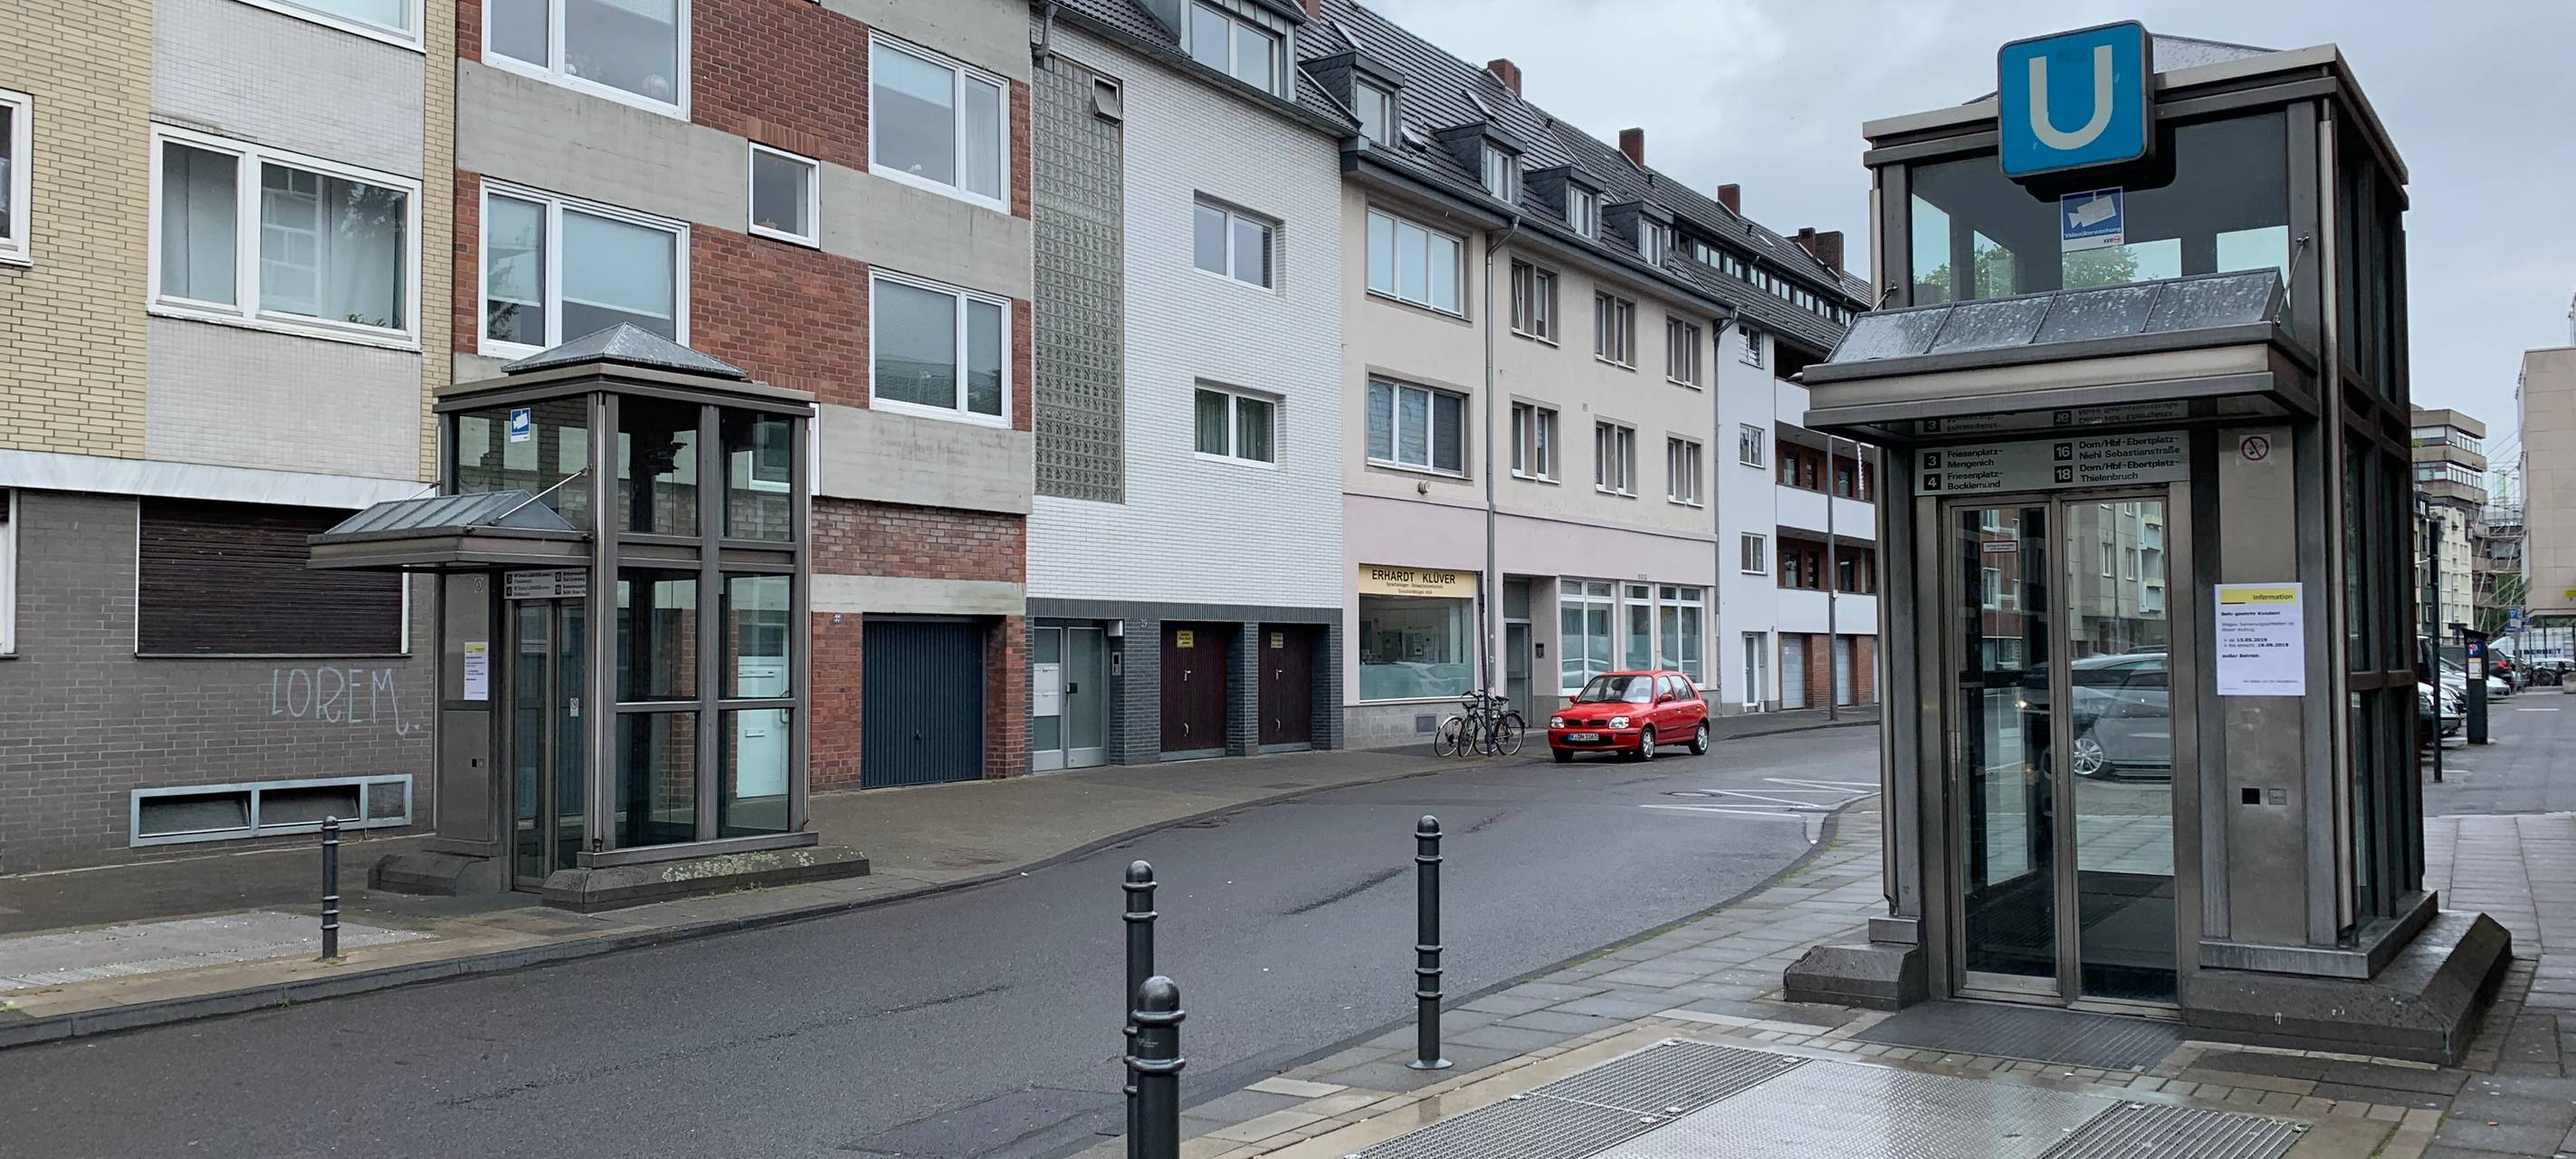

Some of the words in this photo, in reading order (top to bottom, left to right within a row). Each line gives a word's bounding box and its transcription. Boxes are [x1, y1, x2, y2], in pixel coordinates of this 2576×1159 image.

[2029, 44, 2113, 150] U
[1947, 448, 2004, 458] Friesenplatz-
[2056, 445, 2070, 457] 16
[2079, 451, 2103, 460] Niehl
[2104, 445, 2180, 458] Sebastianstraße
[1928, 456, 1937, 466] 3
[1947, 459, 1994, 469] Mengenich
[1947, 471, 2004, 481] Friesenplatz-
[2056, 468, 2071, 481] 18
[2080, 472, 2139, 483] Thielenbruch
[1927, 477, 1937, 487] 4
[1371, 570, 1415, 582] ERHARDT
